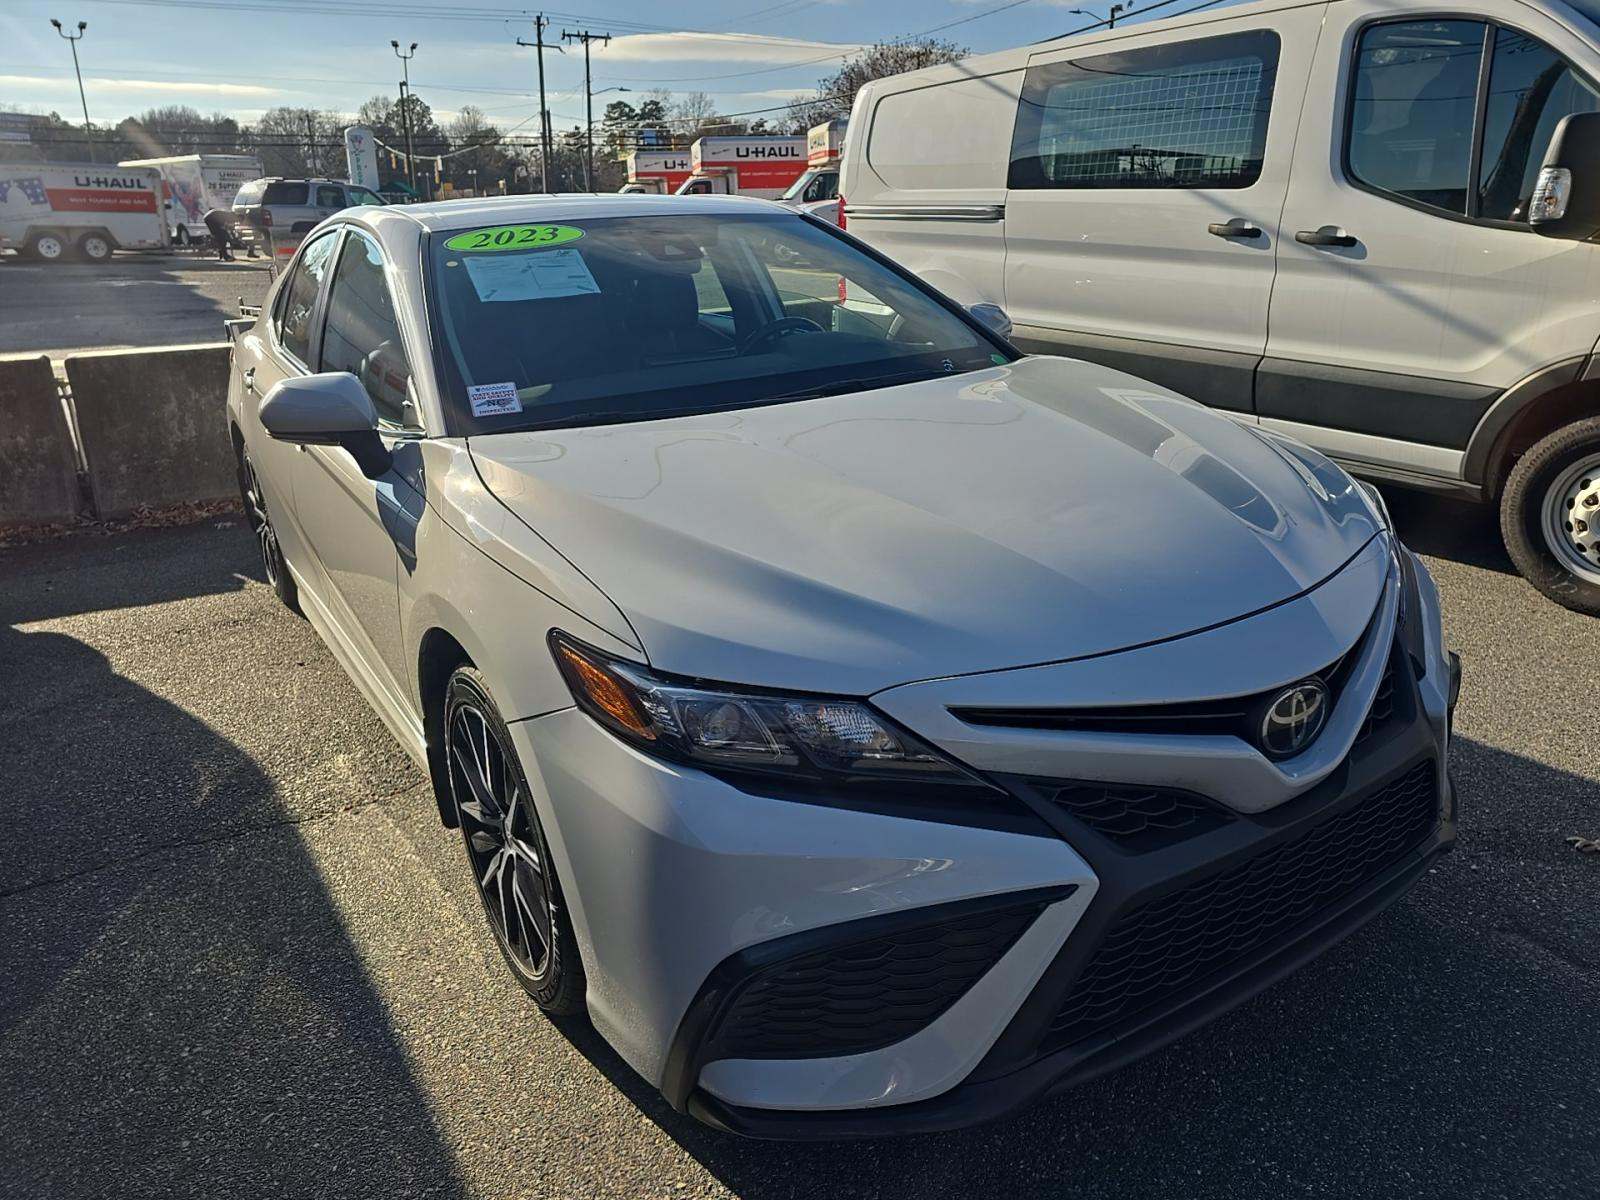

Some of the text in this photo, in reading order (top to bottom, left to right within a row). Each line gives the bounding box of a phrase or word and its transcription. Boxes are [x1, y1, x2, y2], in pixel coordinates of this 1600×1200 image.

[736, 146, 800, 158] U-HAUL
[74, 175, 147, 189] U-HAUL
[470, 227, 559, 249] 2023
